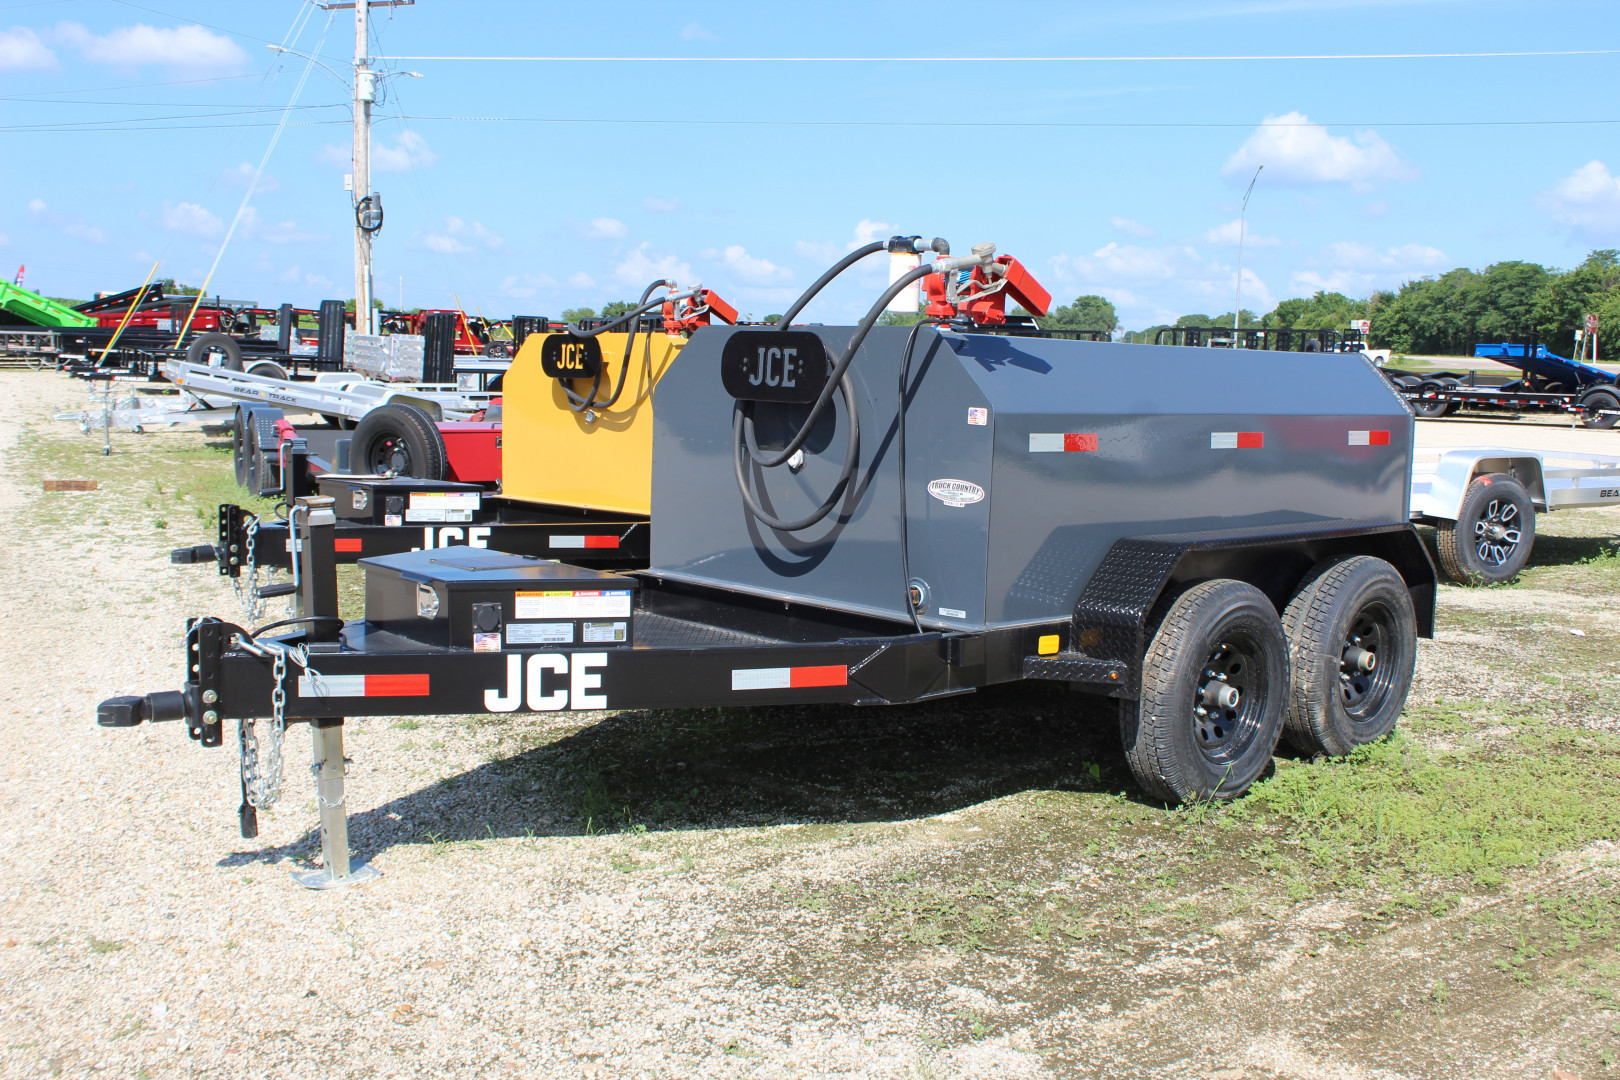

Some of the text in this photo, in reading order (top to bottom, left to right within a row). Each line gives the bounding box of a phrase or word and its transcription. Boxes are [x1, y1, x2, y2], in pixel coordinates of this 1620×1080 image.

[556, 343, 584, 369] JCE
[748, 347, 797, 388] JCE
[234, 387, 297, 402] BEAR TRACK
[932, 481, 951, 490] TRUCK
[952, 483, 980, 494] COUNTRY
[484, 652, 608, 713] JCE
